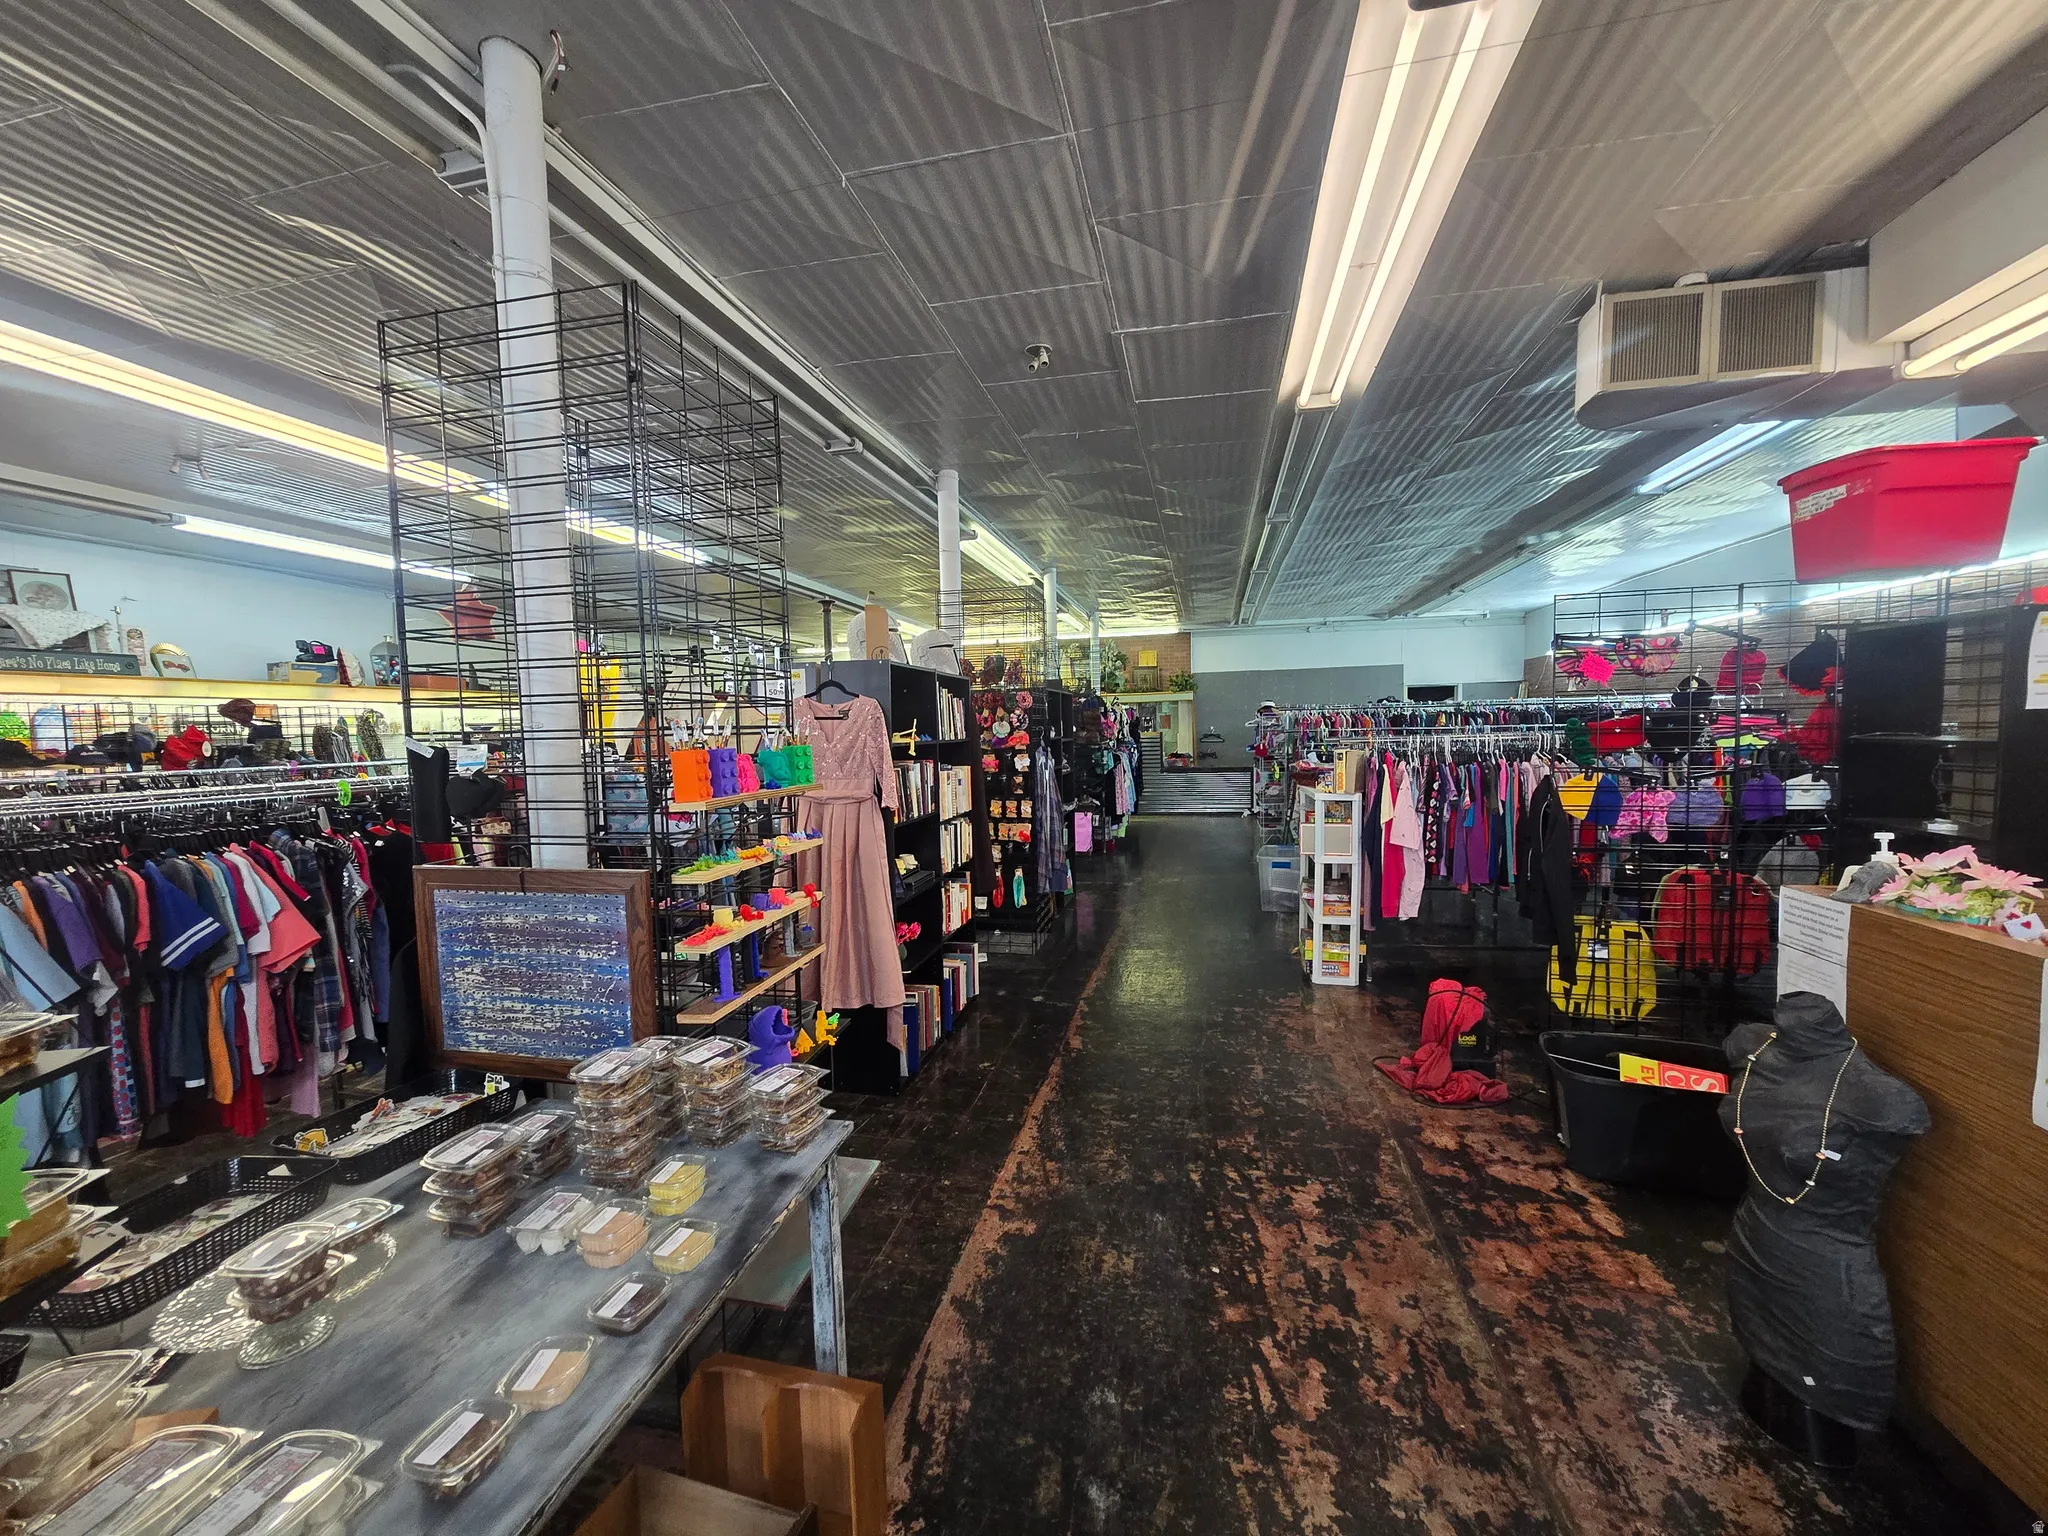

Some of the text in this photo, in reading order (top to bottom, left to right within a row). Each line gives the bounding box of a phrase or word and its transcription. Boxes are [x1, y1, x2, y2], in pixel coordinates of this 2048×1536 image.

[28, 655, 43, 669] No
[73, 658, 95, 674] Like
[96, 659, 121, 672] Home
